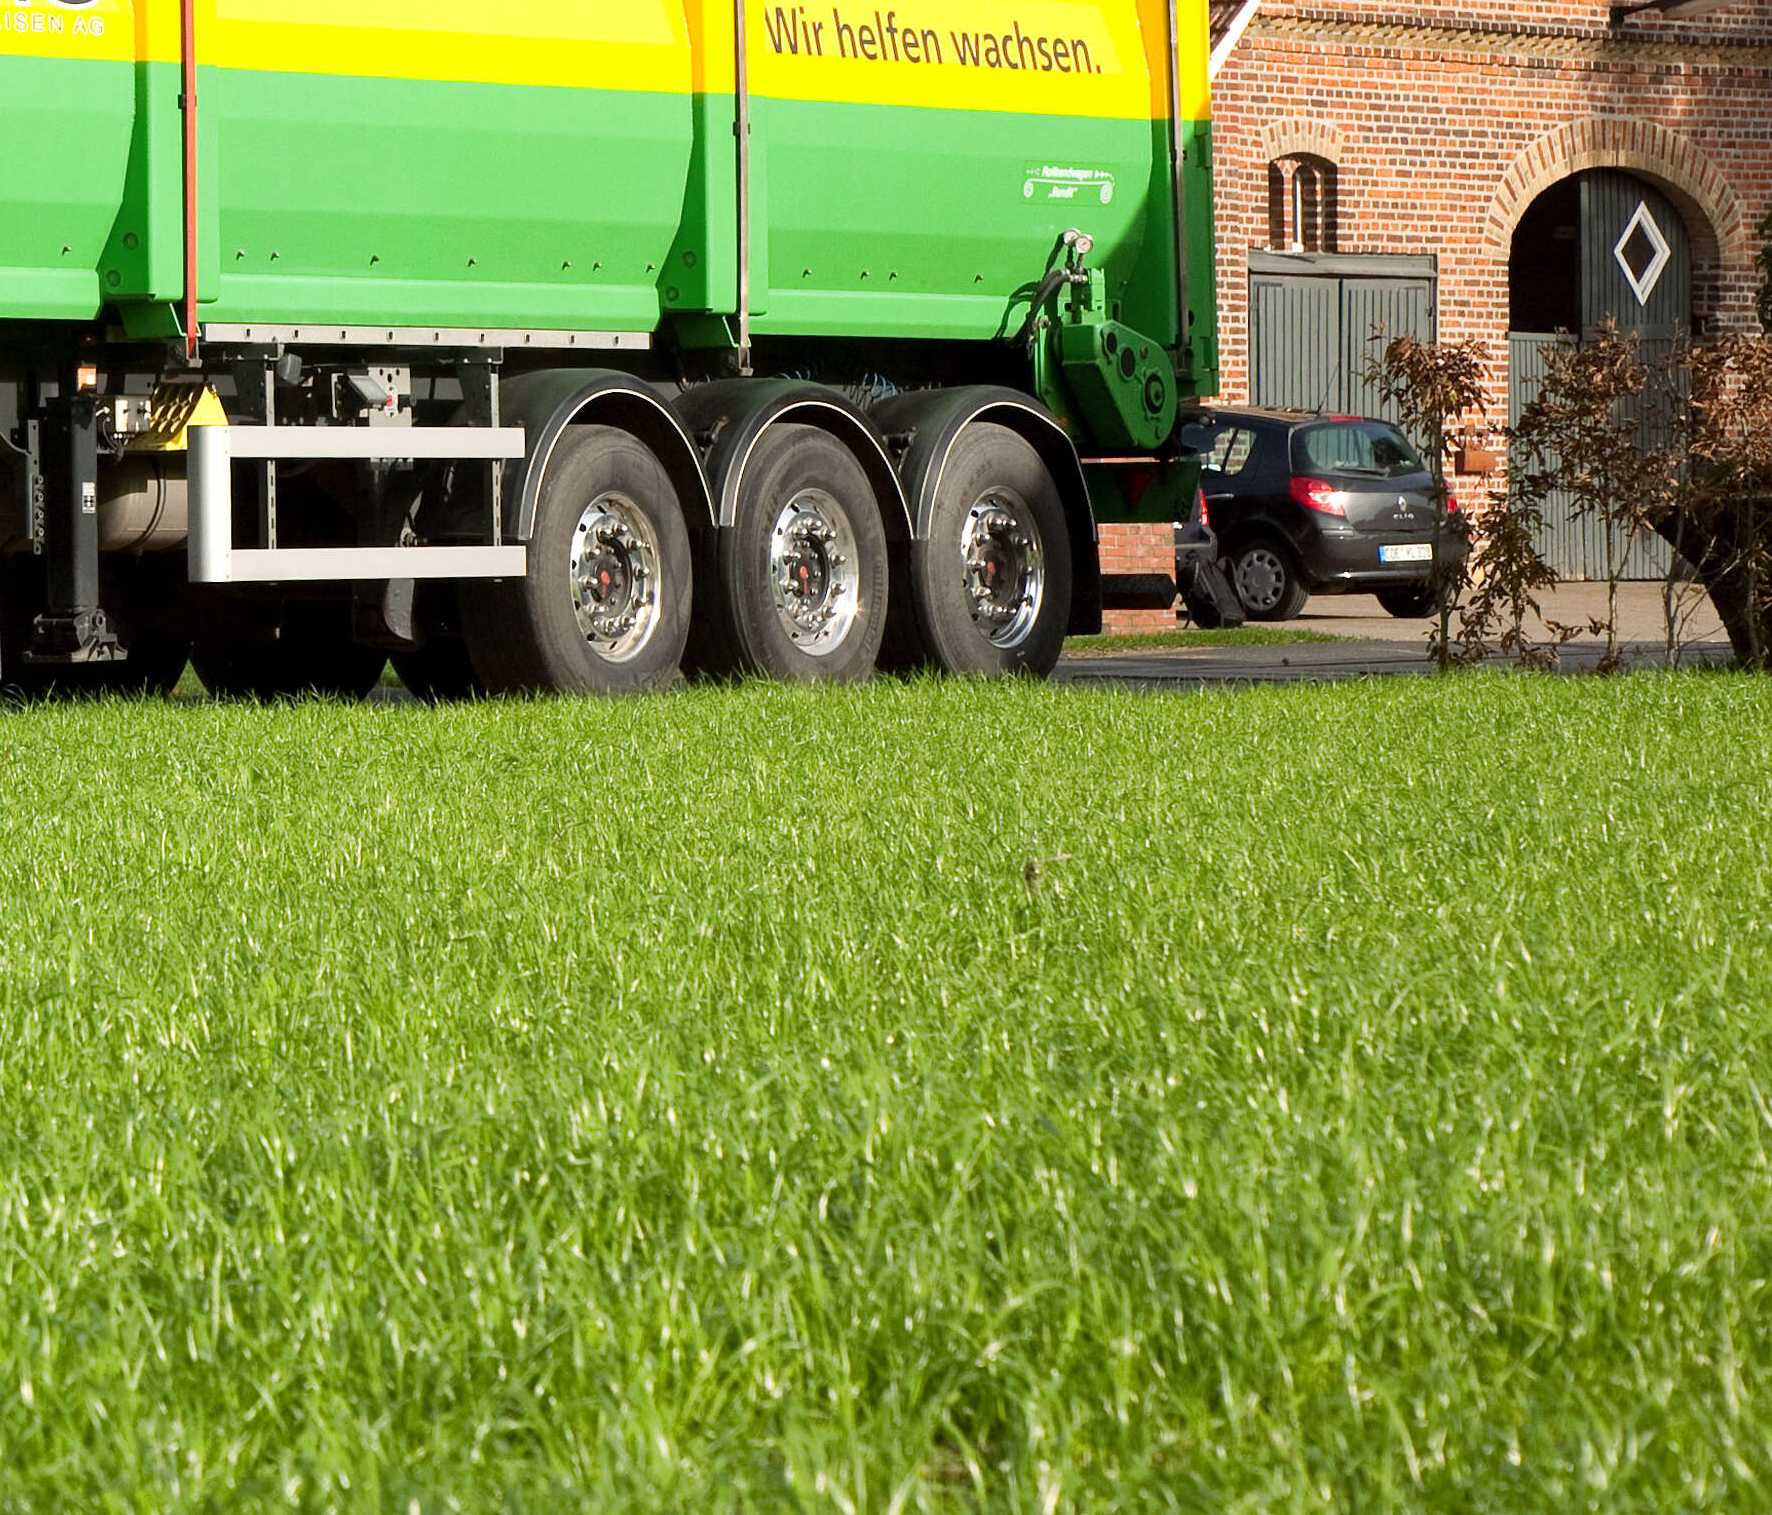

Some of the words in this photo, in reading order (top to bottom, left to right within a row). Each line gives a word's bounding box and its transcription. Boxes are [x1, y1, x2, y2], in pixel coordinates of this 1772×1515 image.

[72, 16, 105, 36] AG
[764, 6, 823, 56] Wir
[833, 8, 943, 64] helfen
[951, 20, 1102, 74] wachsen.
